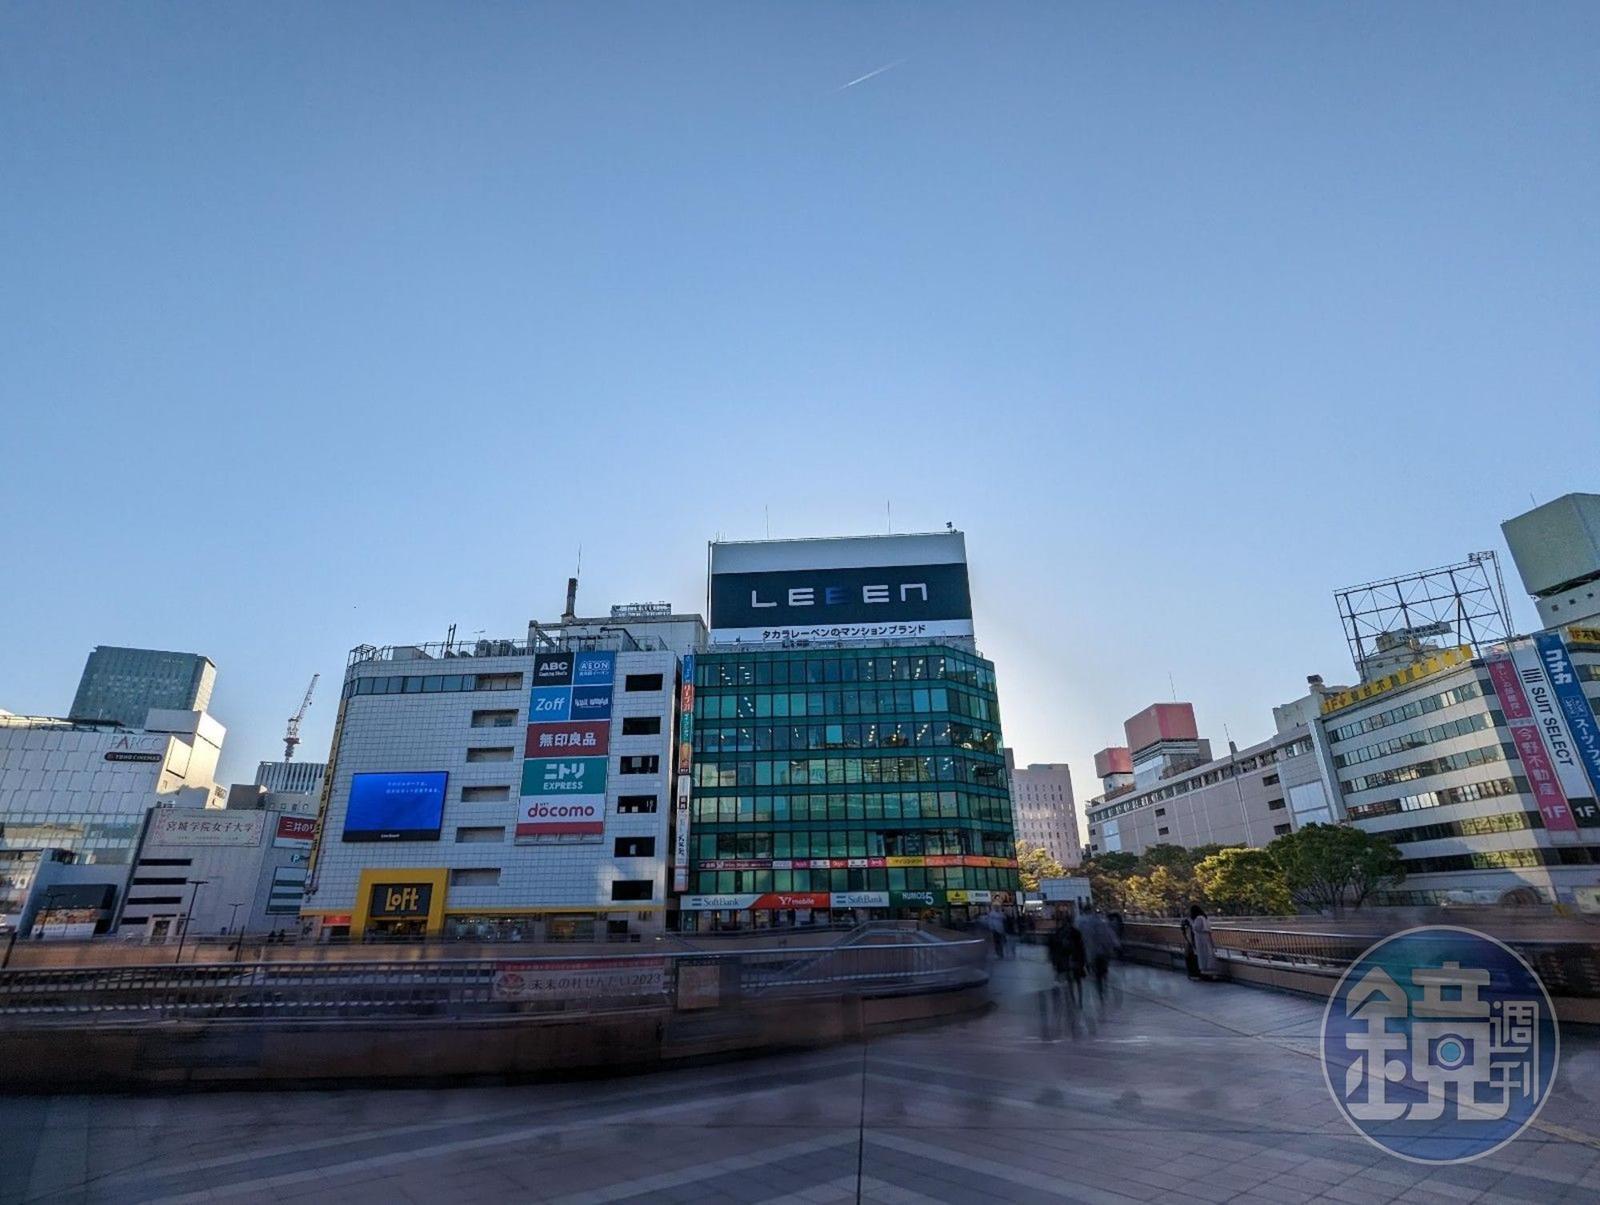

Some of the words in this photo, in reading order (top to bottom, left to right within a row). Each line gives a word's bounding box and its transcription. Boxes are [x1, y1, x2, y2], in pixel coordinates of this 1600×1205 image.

[540, 662, 568, 670] ABC
[581, 661, 609, 669] AEON
[536, 698, 565, 711] Zoff
[1532, 687, 1553, 714] SUIT
[1544, 717, 1574, 766] SELECT
[539, 732, 596, 747] 無印良品
[544, 763, 585, 779] ニトリ
[543, 782, 583, 790] EXPRESS
[528, 804, 595, 818] docomo
[1543, 806, 1566, 818] 1F
[1575, 806, 1595, 817] 1F
[703, 898, 738, 906] SoftBank
[848, 896, 882, 904] SoftBank
